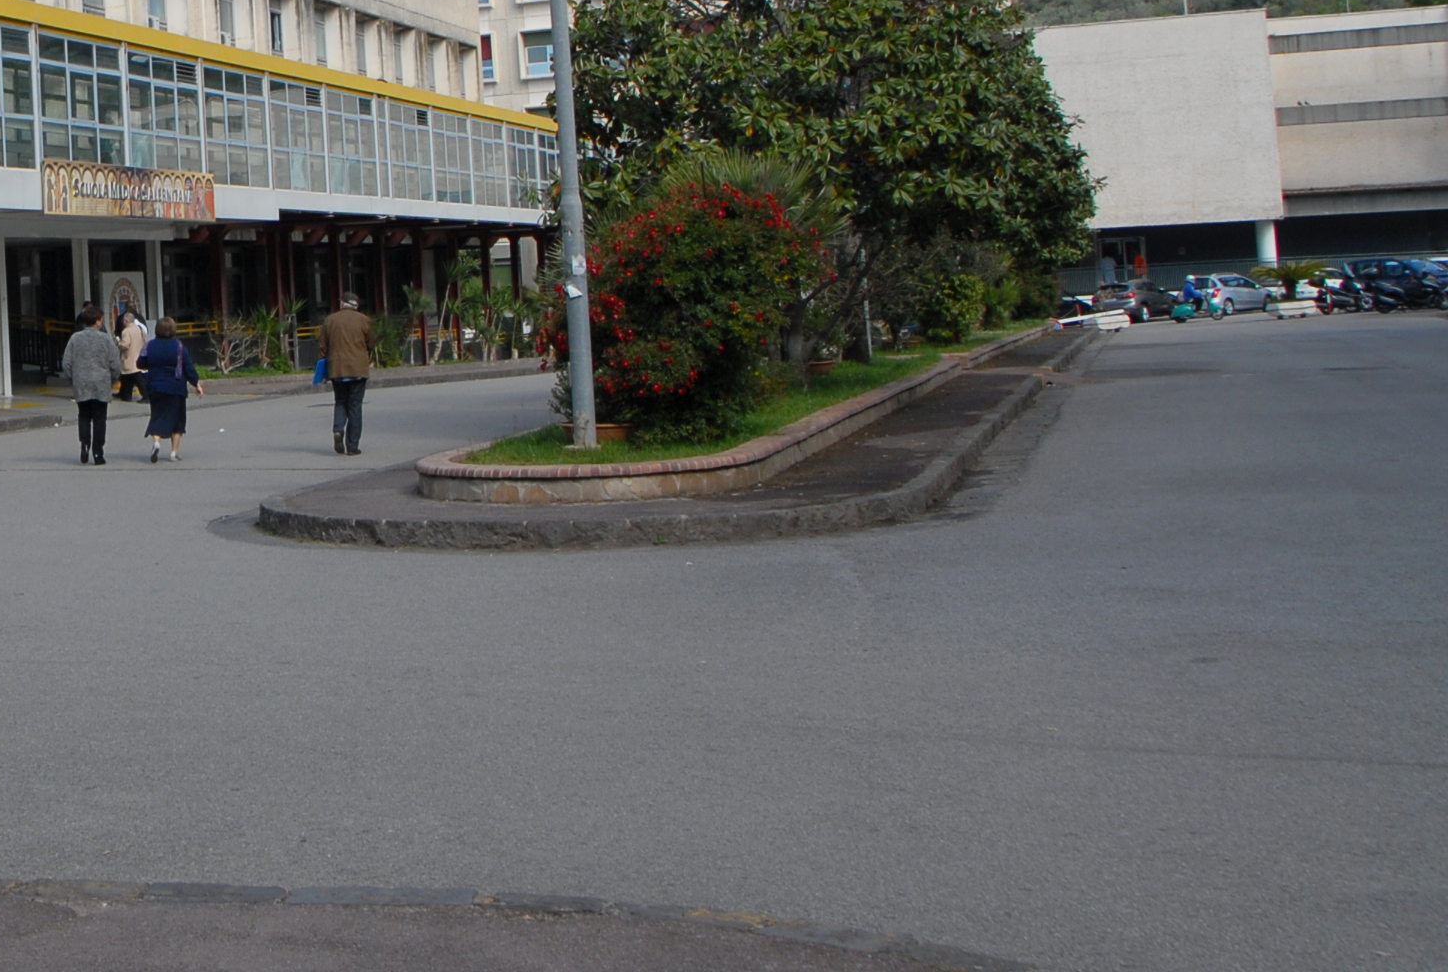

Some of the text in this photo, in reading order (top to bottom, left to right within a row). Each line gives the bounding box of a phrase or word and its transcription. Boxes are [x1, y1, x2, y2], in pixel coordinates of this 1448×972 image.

[73, 177, 193, 204] SCUOLA MEDICA SALERNITANA
